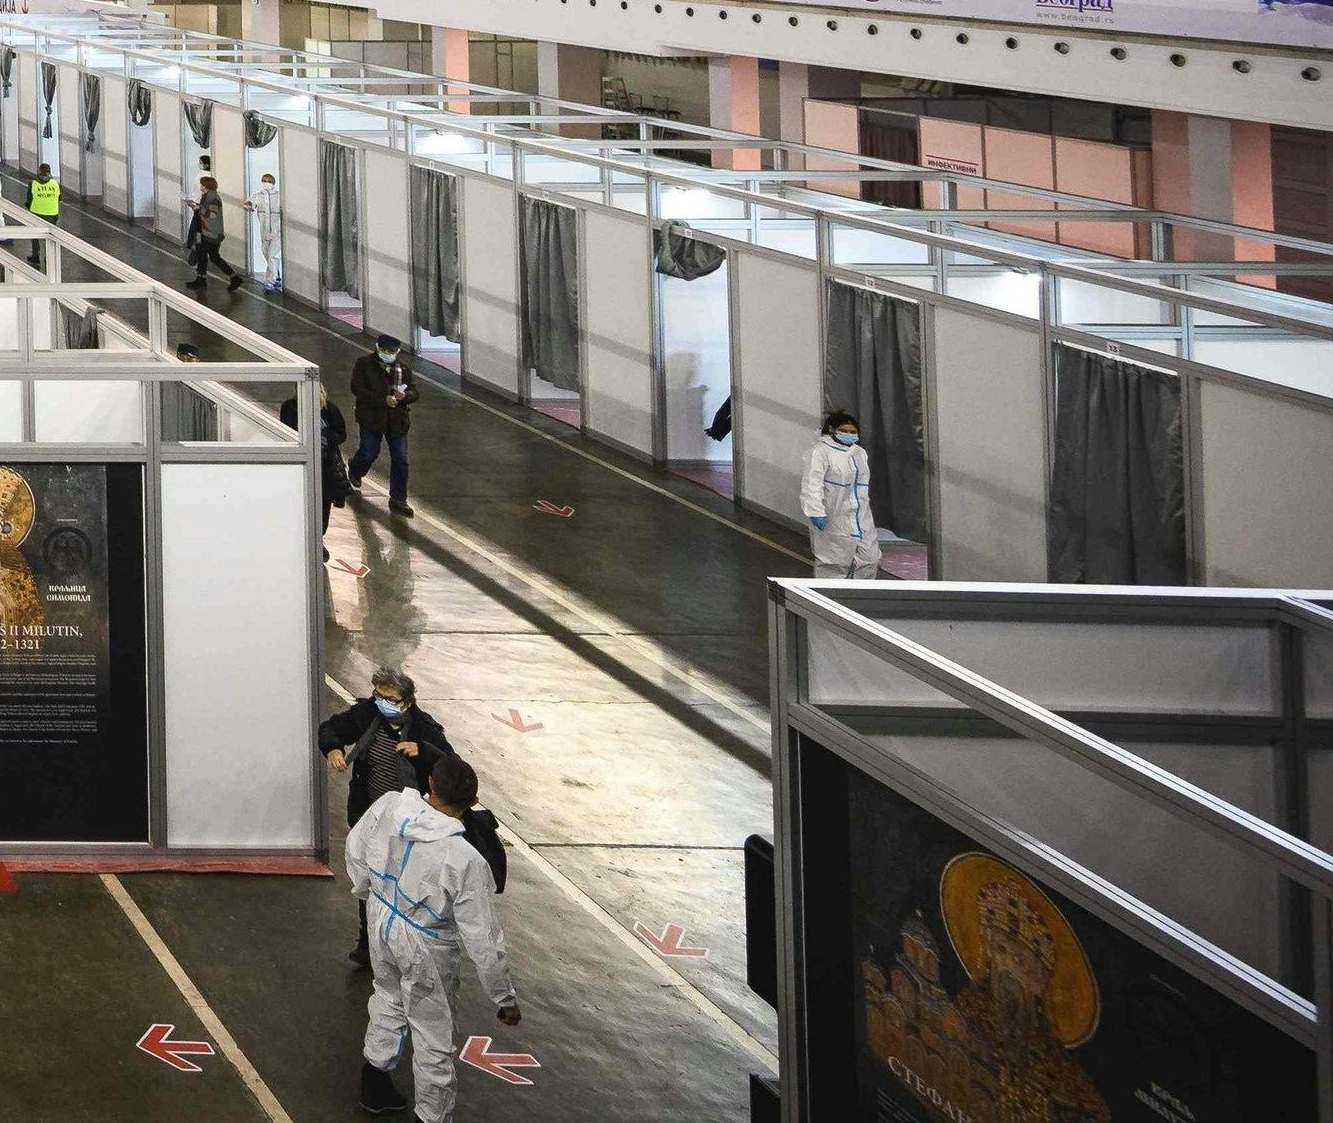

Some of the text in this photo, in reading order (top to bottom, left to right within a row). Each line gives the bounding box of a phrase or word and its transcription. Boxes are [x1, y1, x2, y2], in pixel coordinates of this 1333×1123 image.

[1035, 11, 1115, 25] www.beograd.rs
[9, 626, 19, 636] II
[22, 626, 84, 639] MILUTIN,
